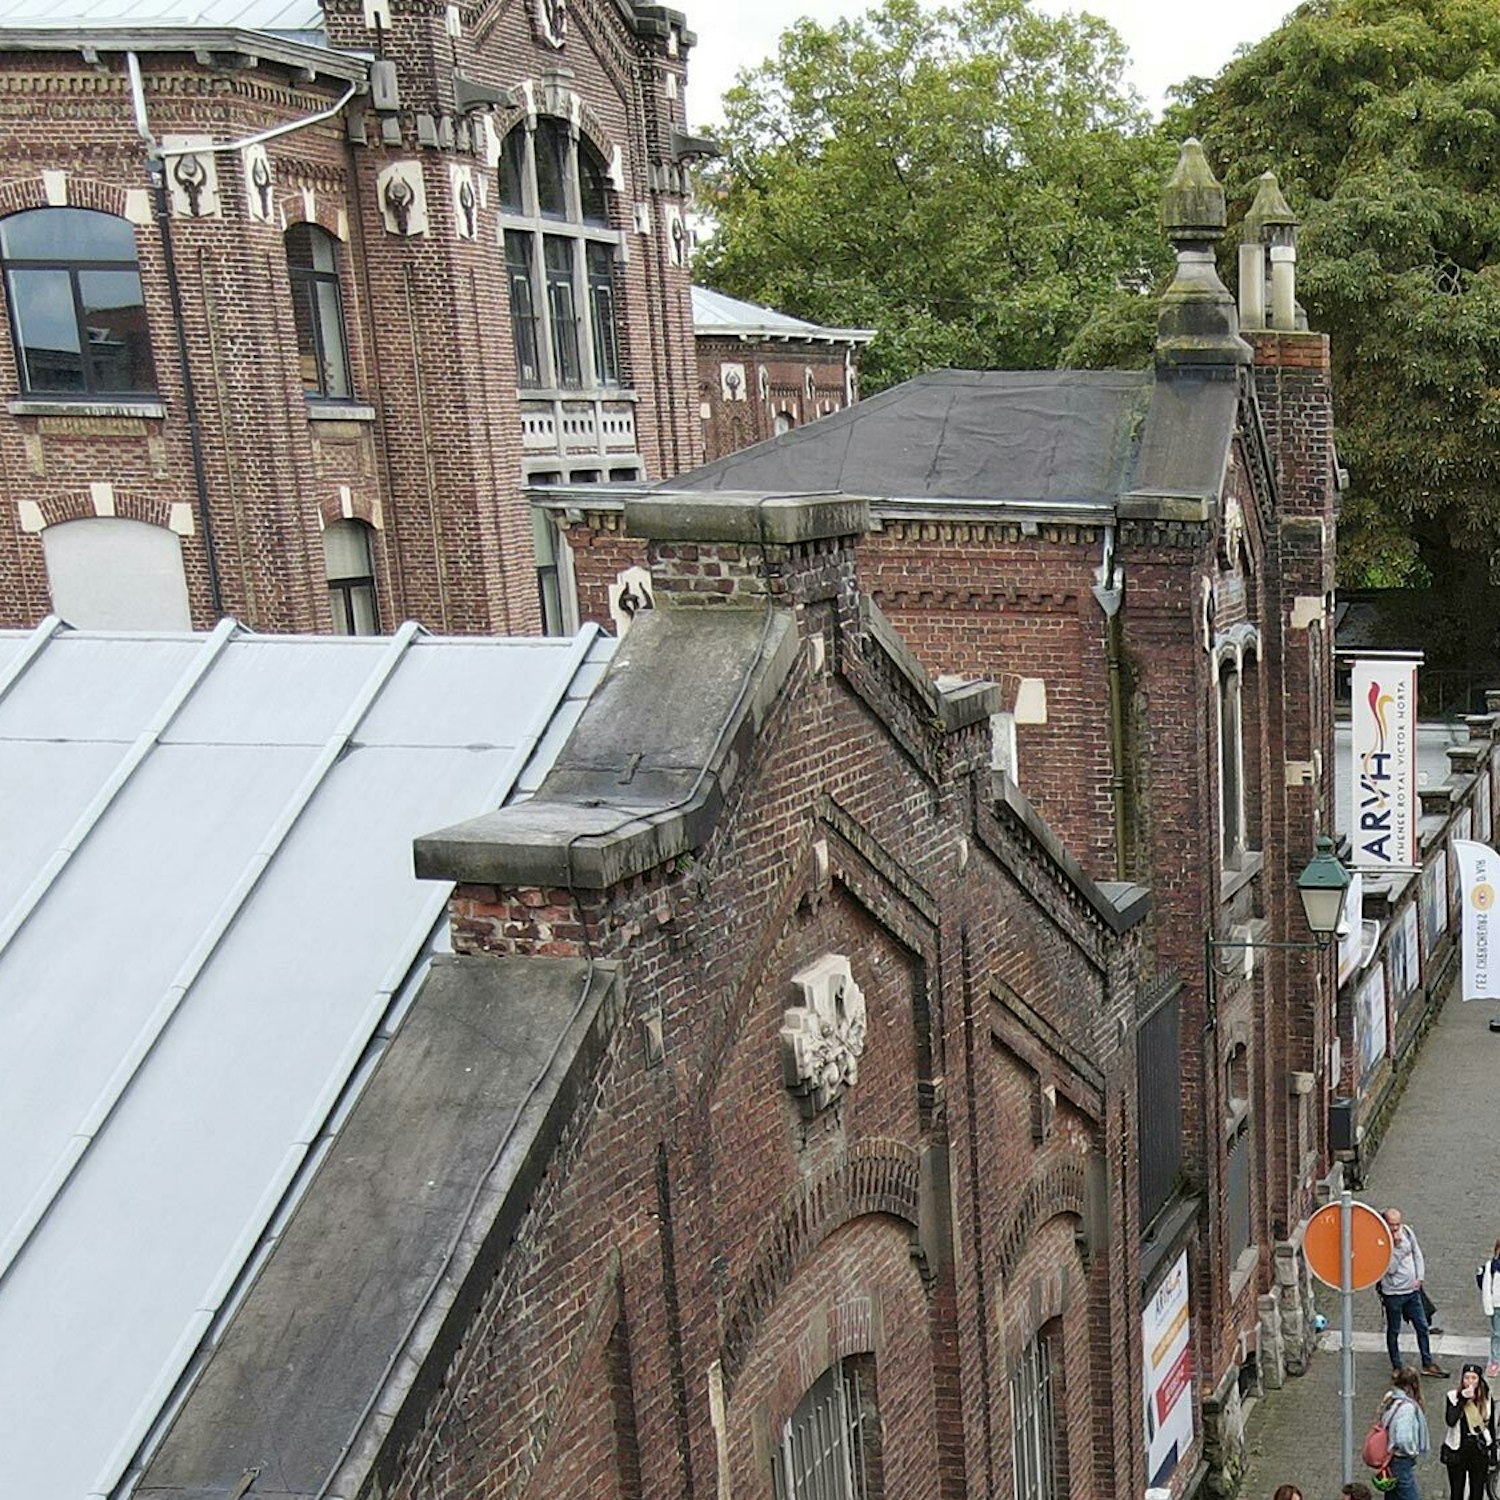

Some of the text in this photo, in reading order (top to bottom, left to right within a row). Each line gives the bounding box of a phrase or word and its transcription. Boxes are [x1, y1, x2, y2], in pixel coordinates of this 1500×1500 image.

[1396, 681, 1406, 719] HORTA
[1396, 725, 1406, 765] VICTOR
[1360, 752, 1392, 863] ARVH
[1396, 772, 1406, 807] ROYAL
